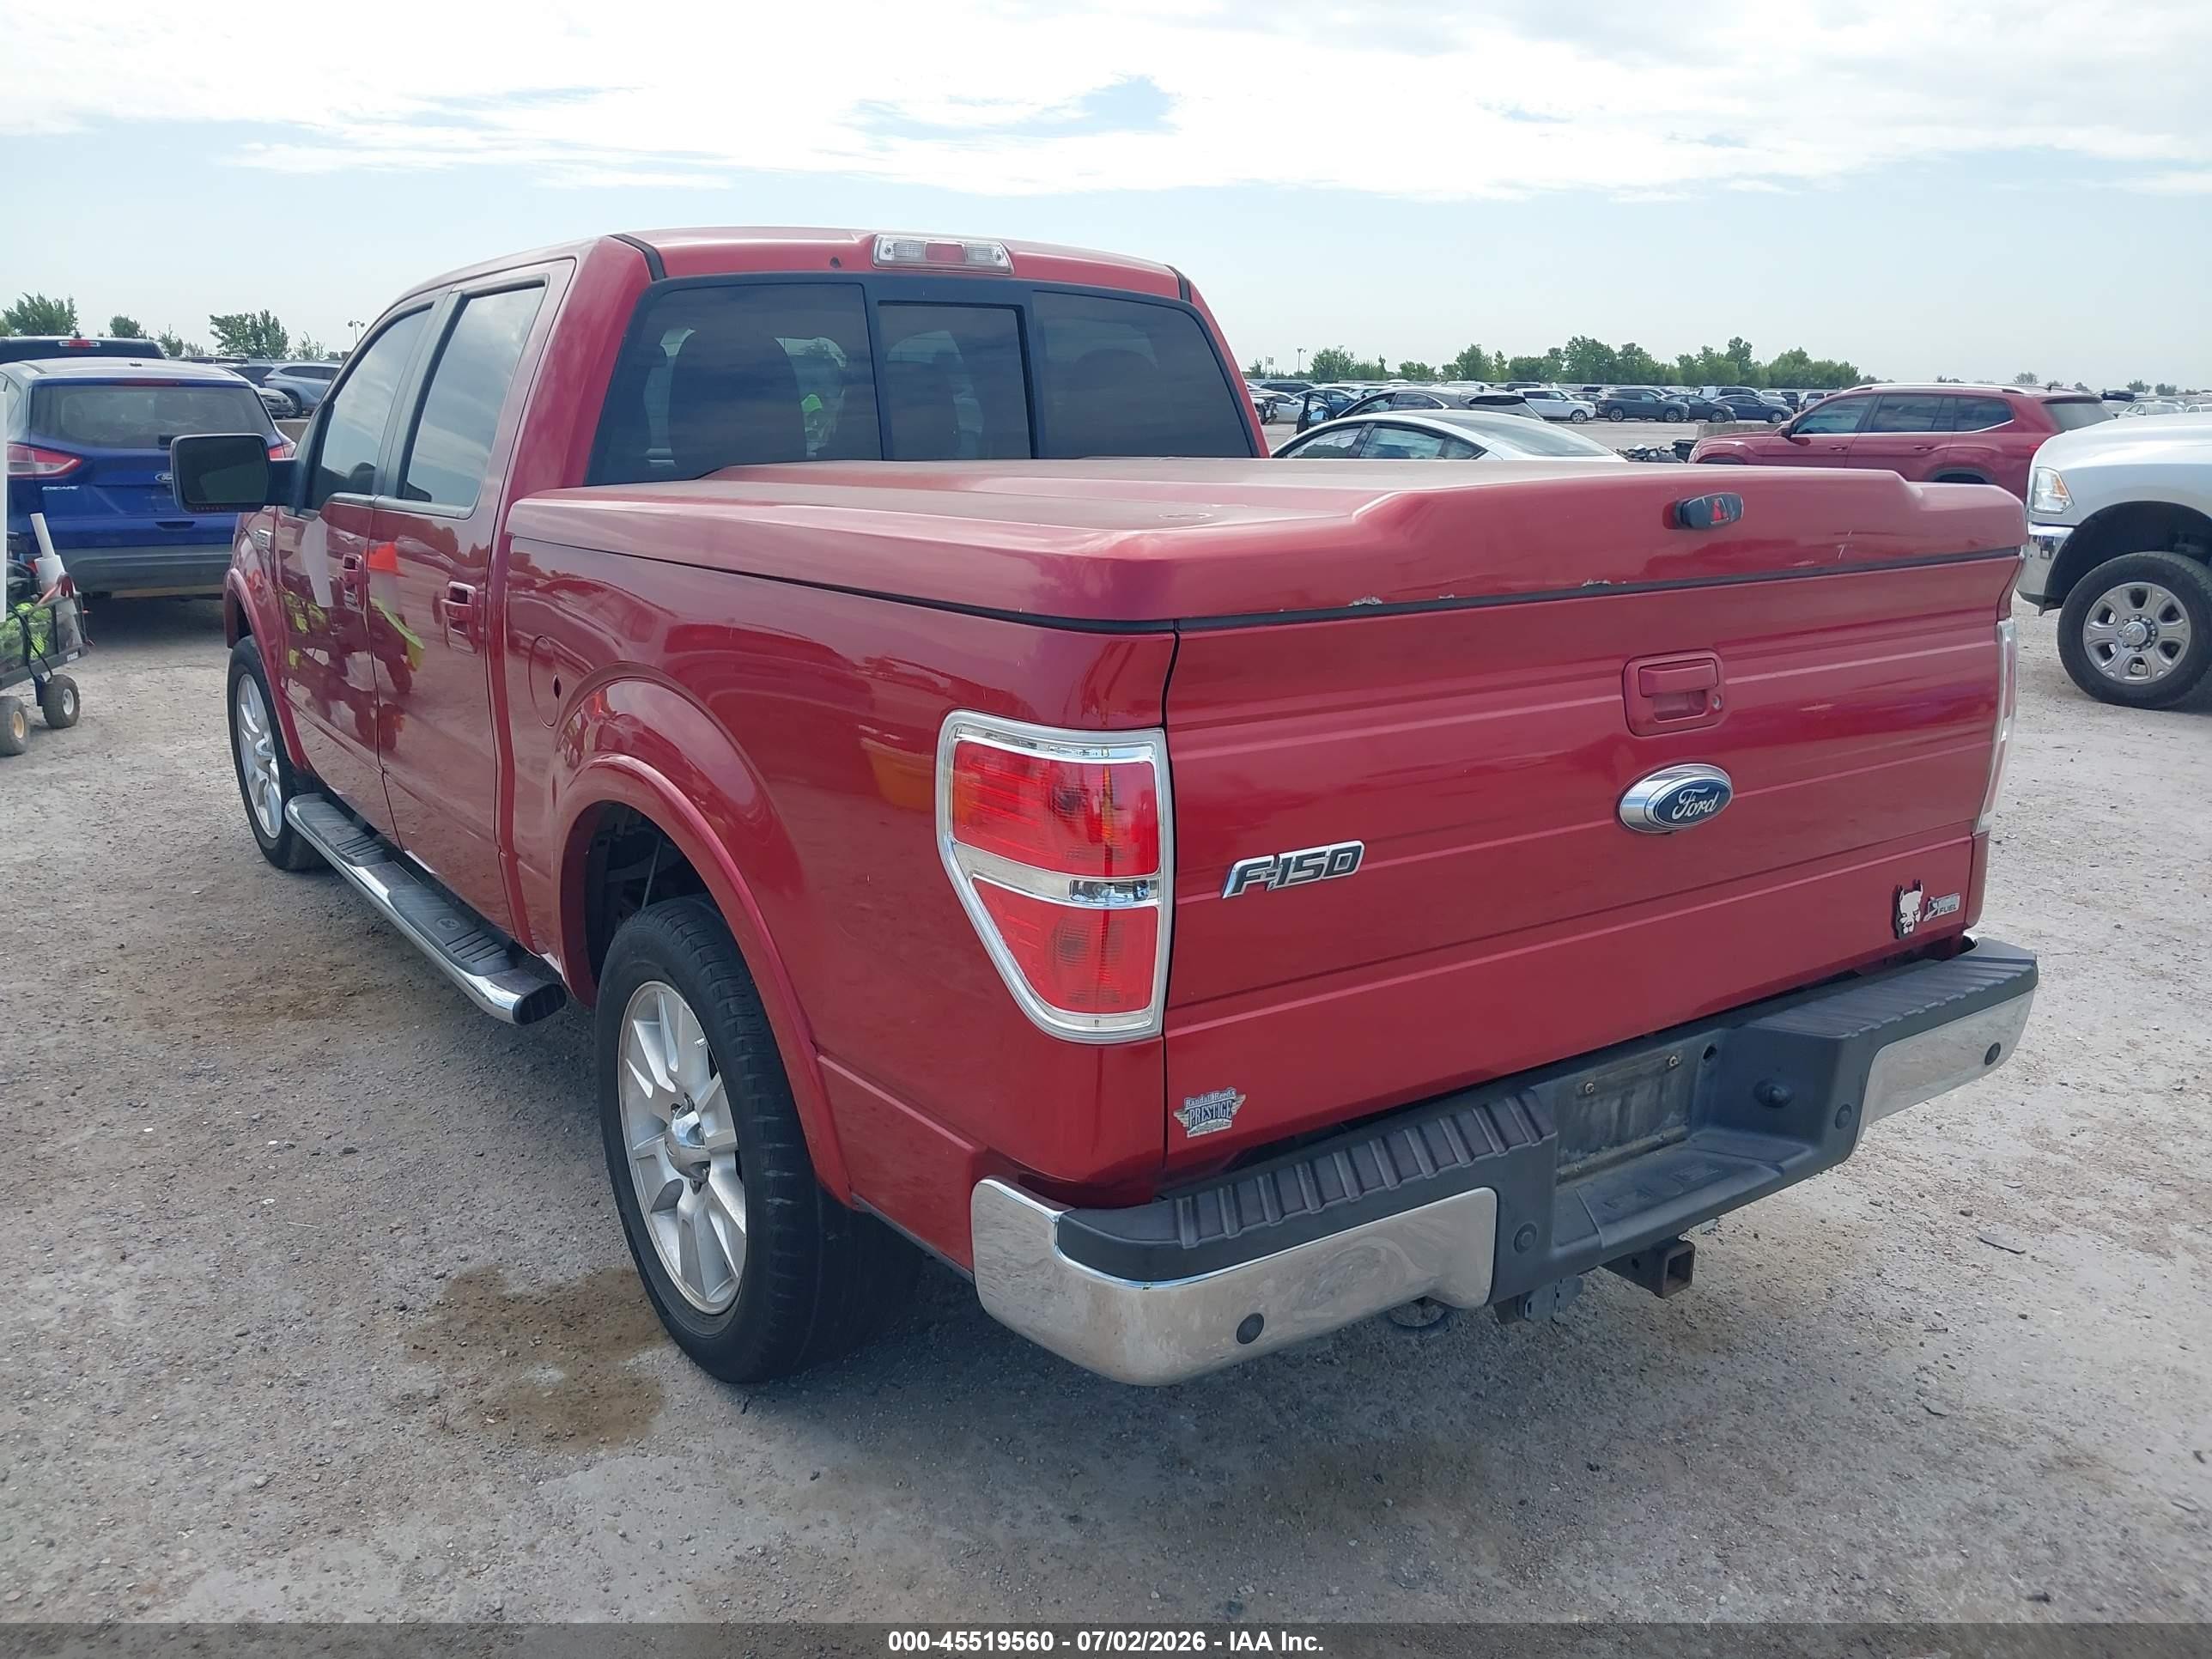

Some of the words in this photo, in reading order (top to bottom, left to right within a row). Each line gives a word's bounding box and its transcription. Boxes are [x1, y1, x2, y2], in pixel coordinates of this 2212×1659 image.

[1672, 787, 1720, 820] Ford
[1222, 840, 1365, 899] F-150
[1939, 903, 1957, 915] FUEL
[1185, 1092, 1212, 1109] Randall
[1188, 1099, 1233, 1129] PRESTIGE
